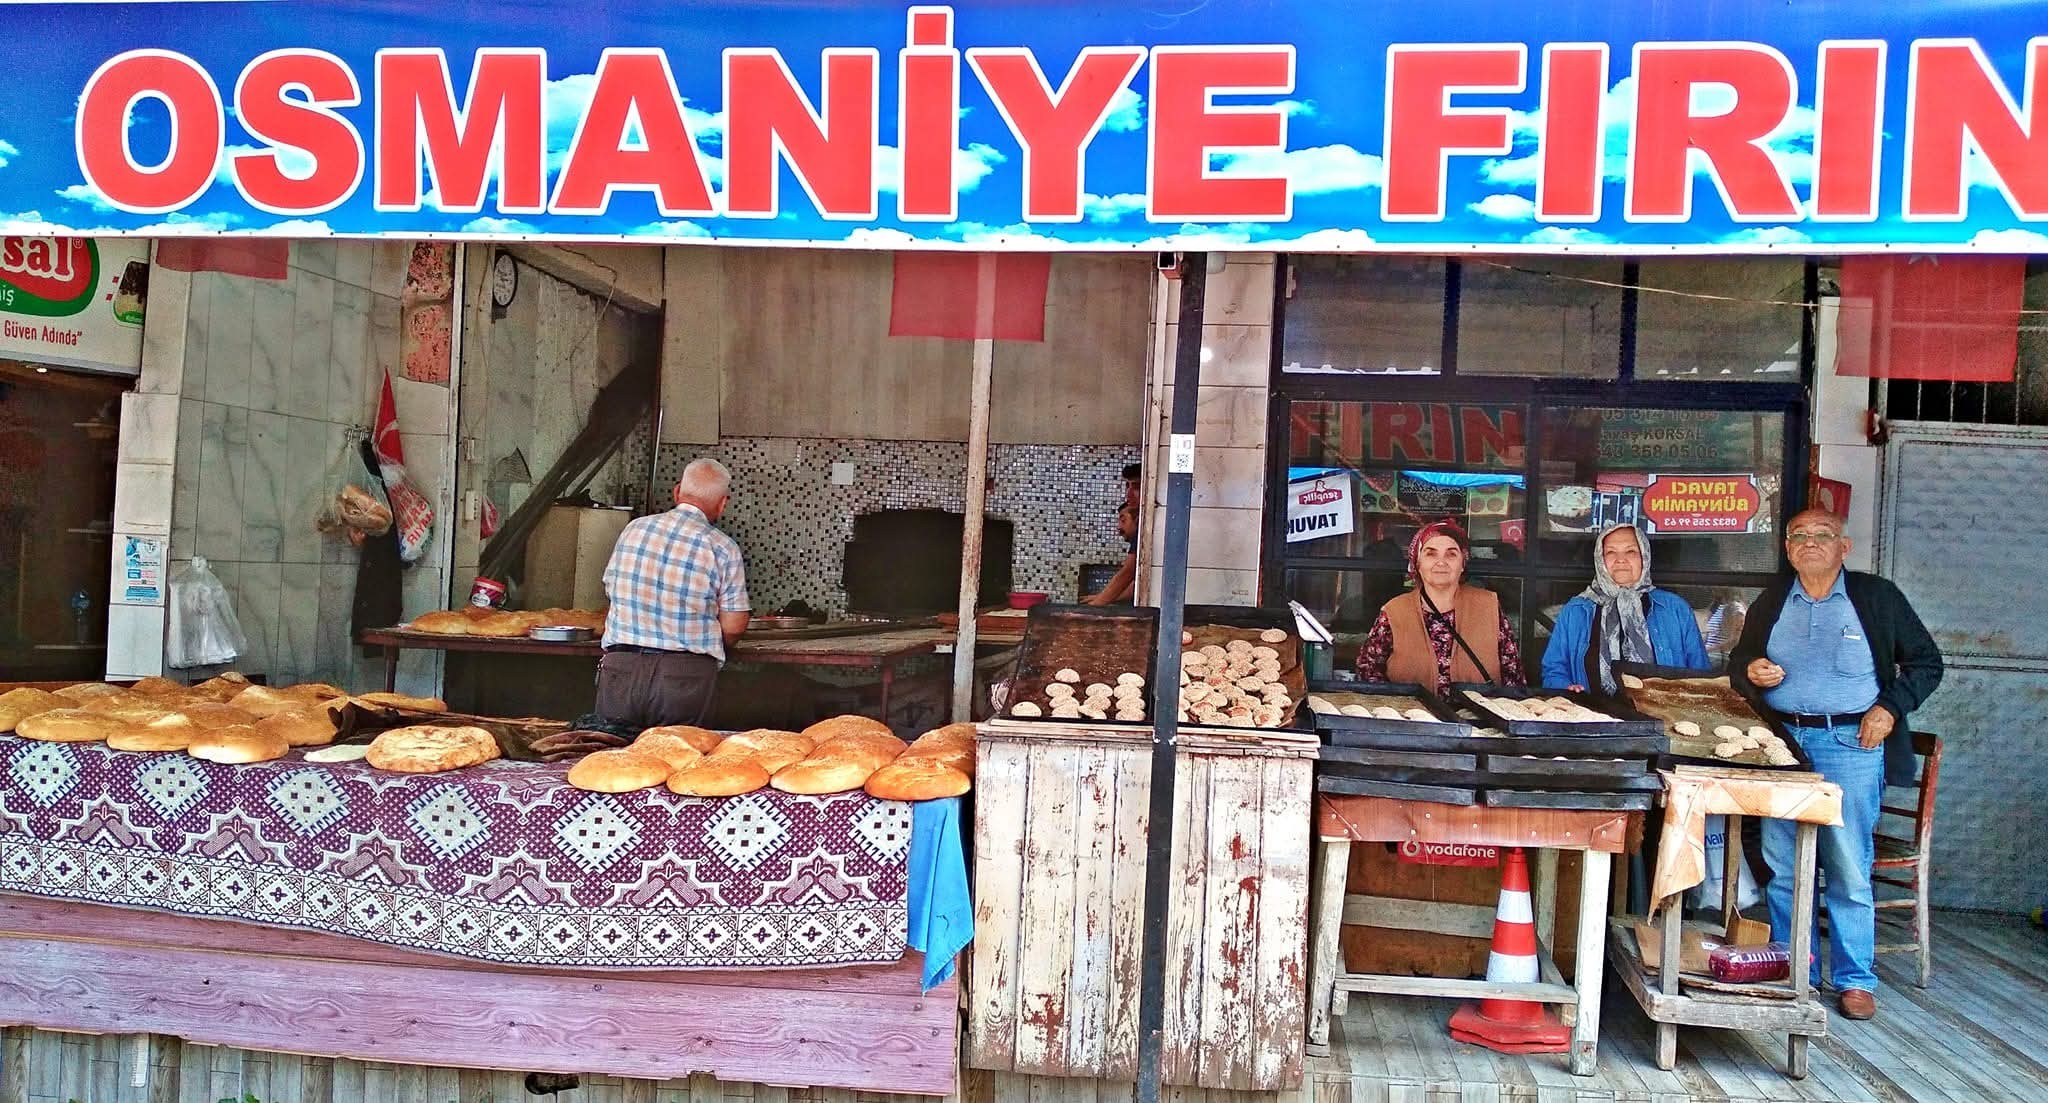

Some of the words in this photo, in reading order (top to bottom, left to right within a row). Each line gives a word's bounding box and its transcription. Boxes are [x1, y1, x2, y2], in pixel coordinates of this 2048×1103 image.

[76, 7, 1295, 222] OSMANİYE
[1381, 38, 2048, 222] FIRIN
[4, 319, 37, 340] Güven
[1290, 402, 1526, 467] FIRIN
[1643, 427, 1704, 441] KORSAL
[1425, 843, 1496, 859] vodafone
